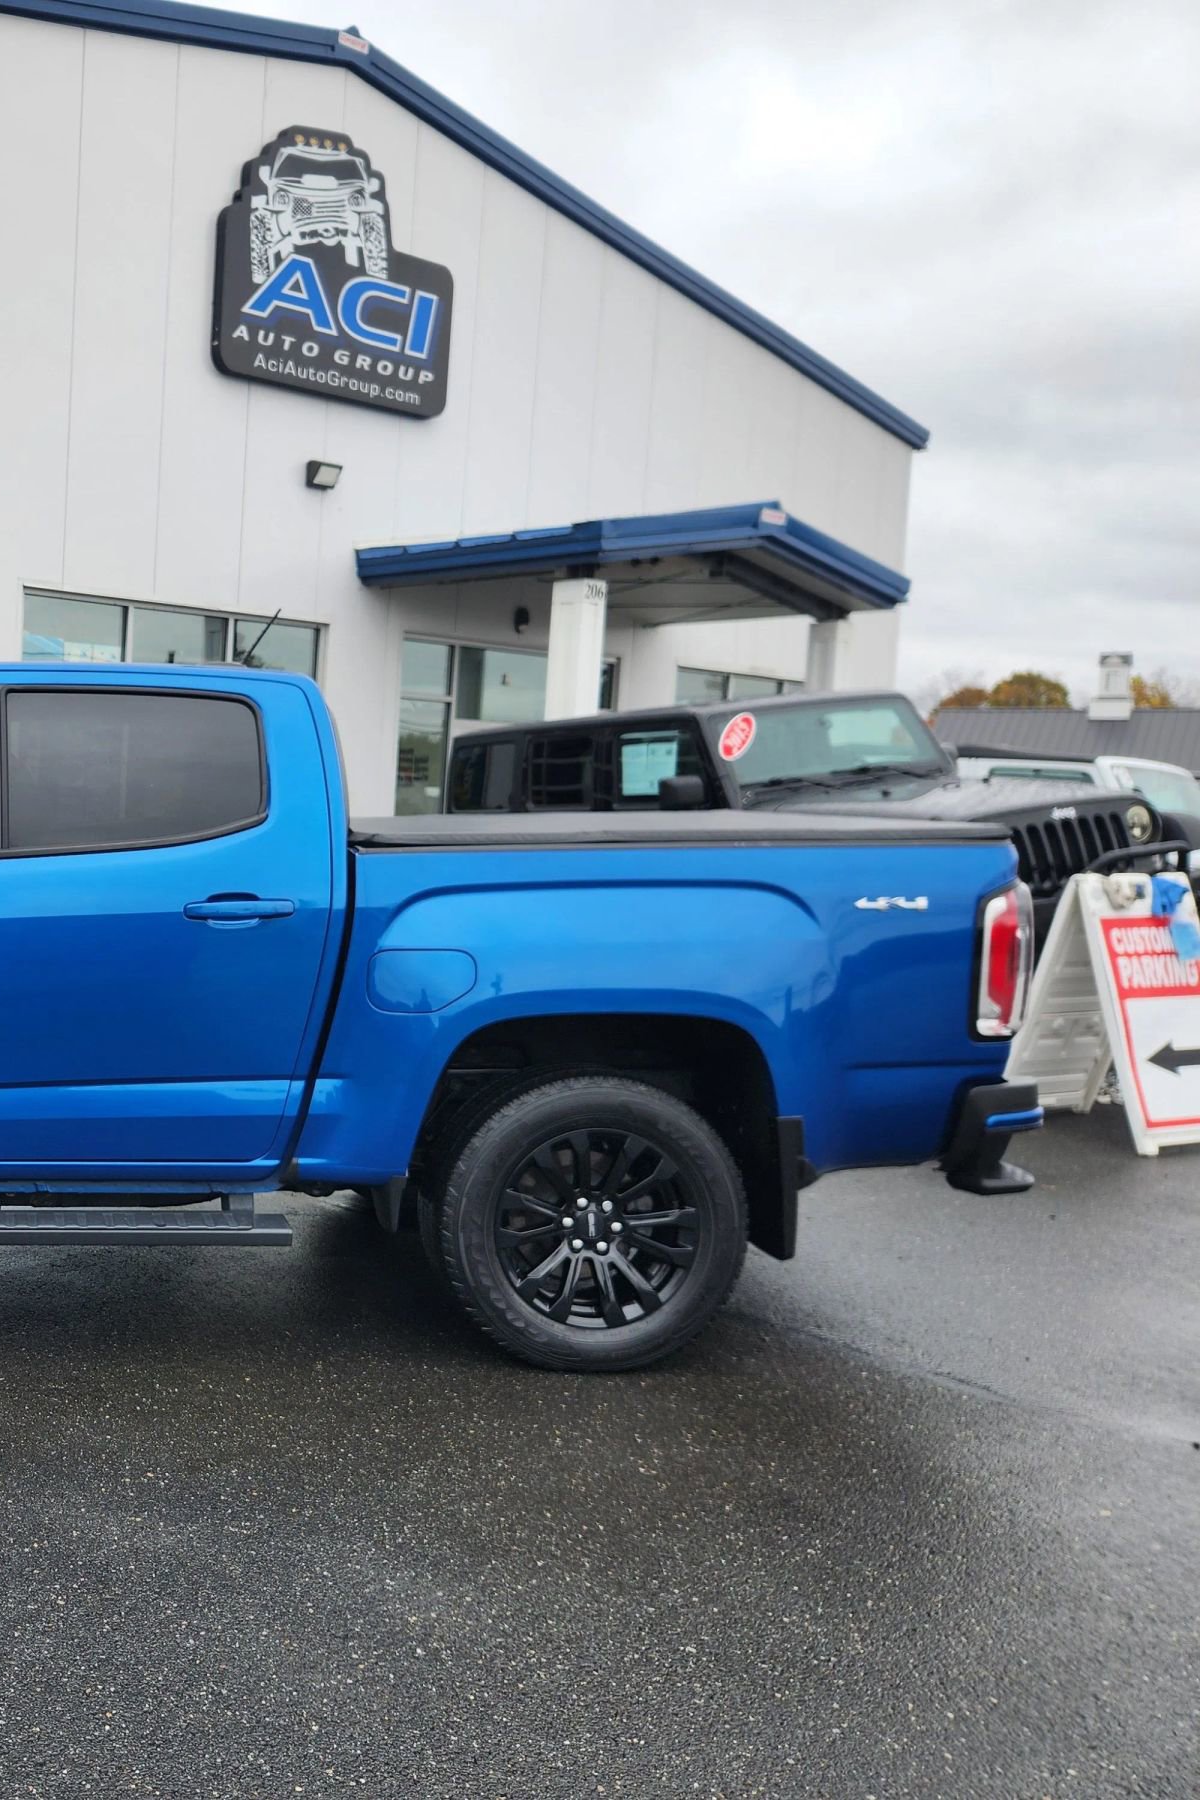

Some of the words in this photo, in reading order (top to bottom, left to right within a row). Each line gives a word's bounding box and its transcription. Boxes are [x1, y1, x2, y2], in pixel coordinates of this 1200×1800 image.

[241, 253, 439, 361] ACI
[232, 324, 320, 358] AUTO
[334, 349, 435, 385] GROUP
[253, 353, 422, 406] AciAutoGroup.com
[1110, 926, 1179, 954] CUSTOM
[1117, 955, 1199, 989] PARKING
